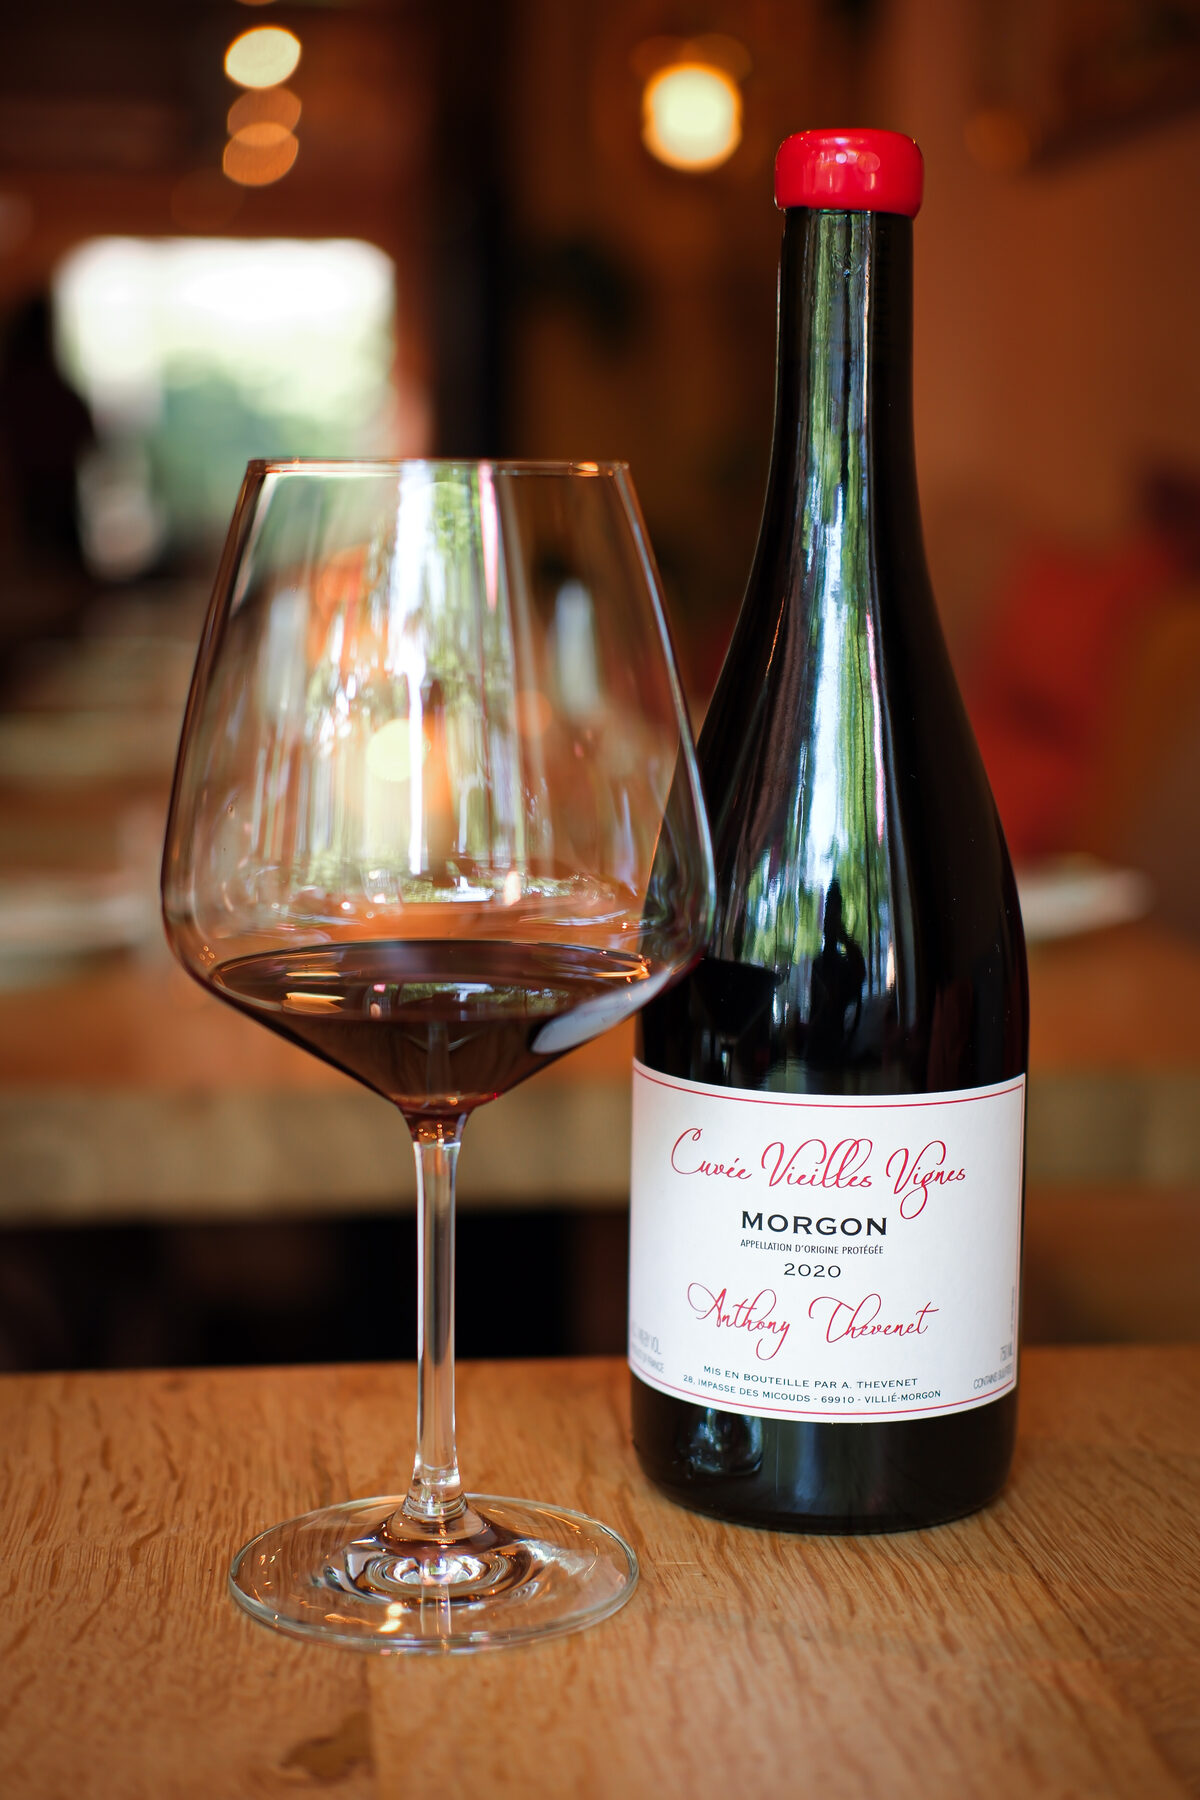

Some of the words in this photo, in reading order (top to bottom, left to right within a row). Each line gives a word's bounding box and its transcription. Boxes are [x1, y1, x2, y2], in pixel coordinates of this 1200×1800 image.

[671, 1128, 753, 1180] Cuvée
[761, 1139, 873, 1189] Vieilles
[886, 1140, 966, 1221] Vignes
[741, 1210, 888, 1237] MORGON
[740, 1239, 792, 1252] APPELLATION
[794, 1244, 839, 1255] D'ORIGINE
[842, 1244, 884, 1255] PROTÉGÉE
[784, 1262, 842, 1279] 2020
[688, 1283, 791, 1361] Anthony
[703, 1365, 722, 1377] MIS
[724, 1370, 739, 1379] EN
[743, 1374, 810, 1388] BOUTEILLE
[814, 1381, 837, 1389] PAR
[841, 1381, 852, 1389] A.
[857, 1378, 918, 1389] THEVENET
[698, 1379, 736, 1394] IMPASSE
[739, 1388, 759, 1398] DES
[763, 1391, 811, 1403] MICOUDS
[821, 1395, 855, 1404] 69910
[864, 1389, 941, 1404] VILLIÉ-MORGON
